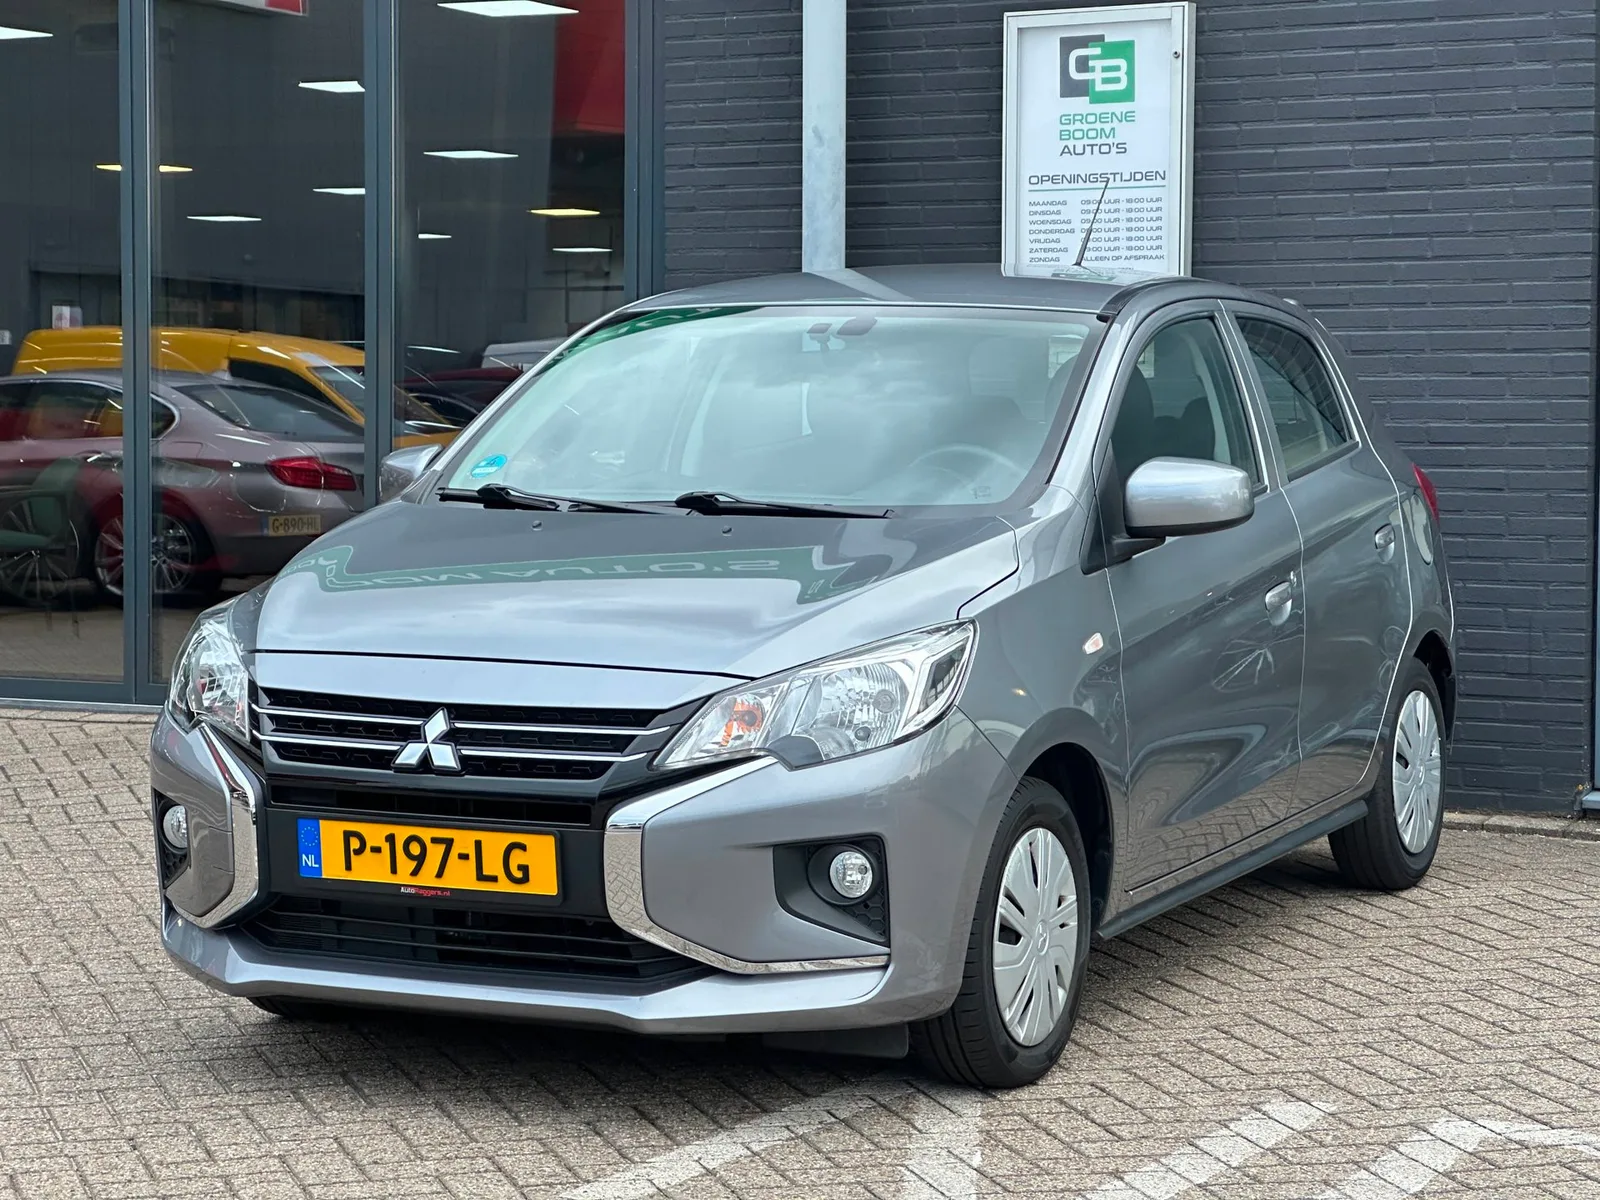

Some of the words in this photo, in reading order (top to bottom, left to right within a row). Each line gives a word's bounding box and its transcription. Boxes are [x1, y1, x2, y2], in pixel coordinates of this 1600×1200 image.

[1059, 110, 1136, 126] GROENE
[1059, 127, 1116, 141] BOOM
[1059, 142, 1128, 157] AUTO'S
[1028, 170, 1167, 186] OPENINGSTIJDEN
[302, 853, 319, 869] NL
[342, 829, 531, 885] P-197-LG
